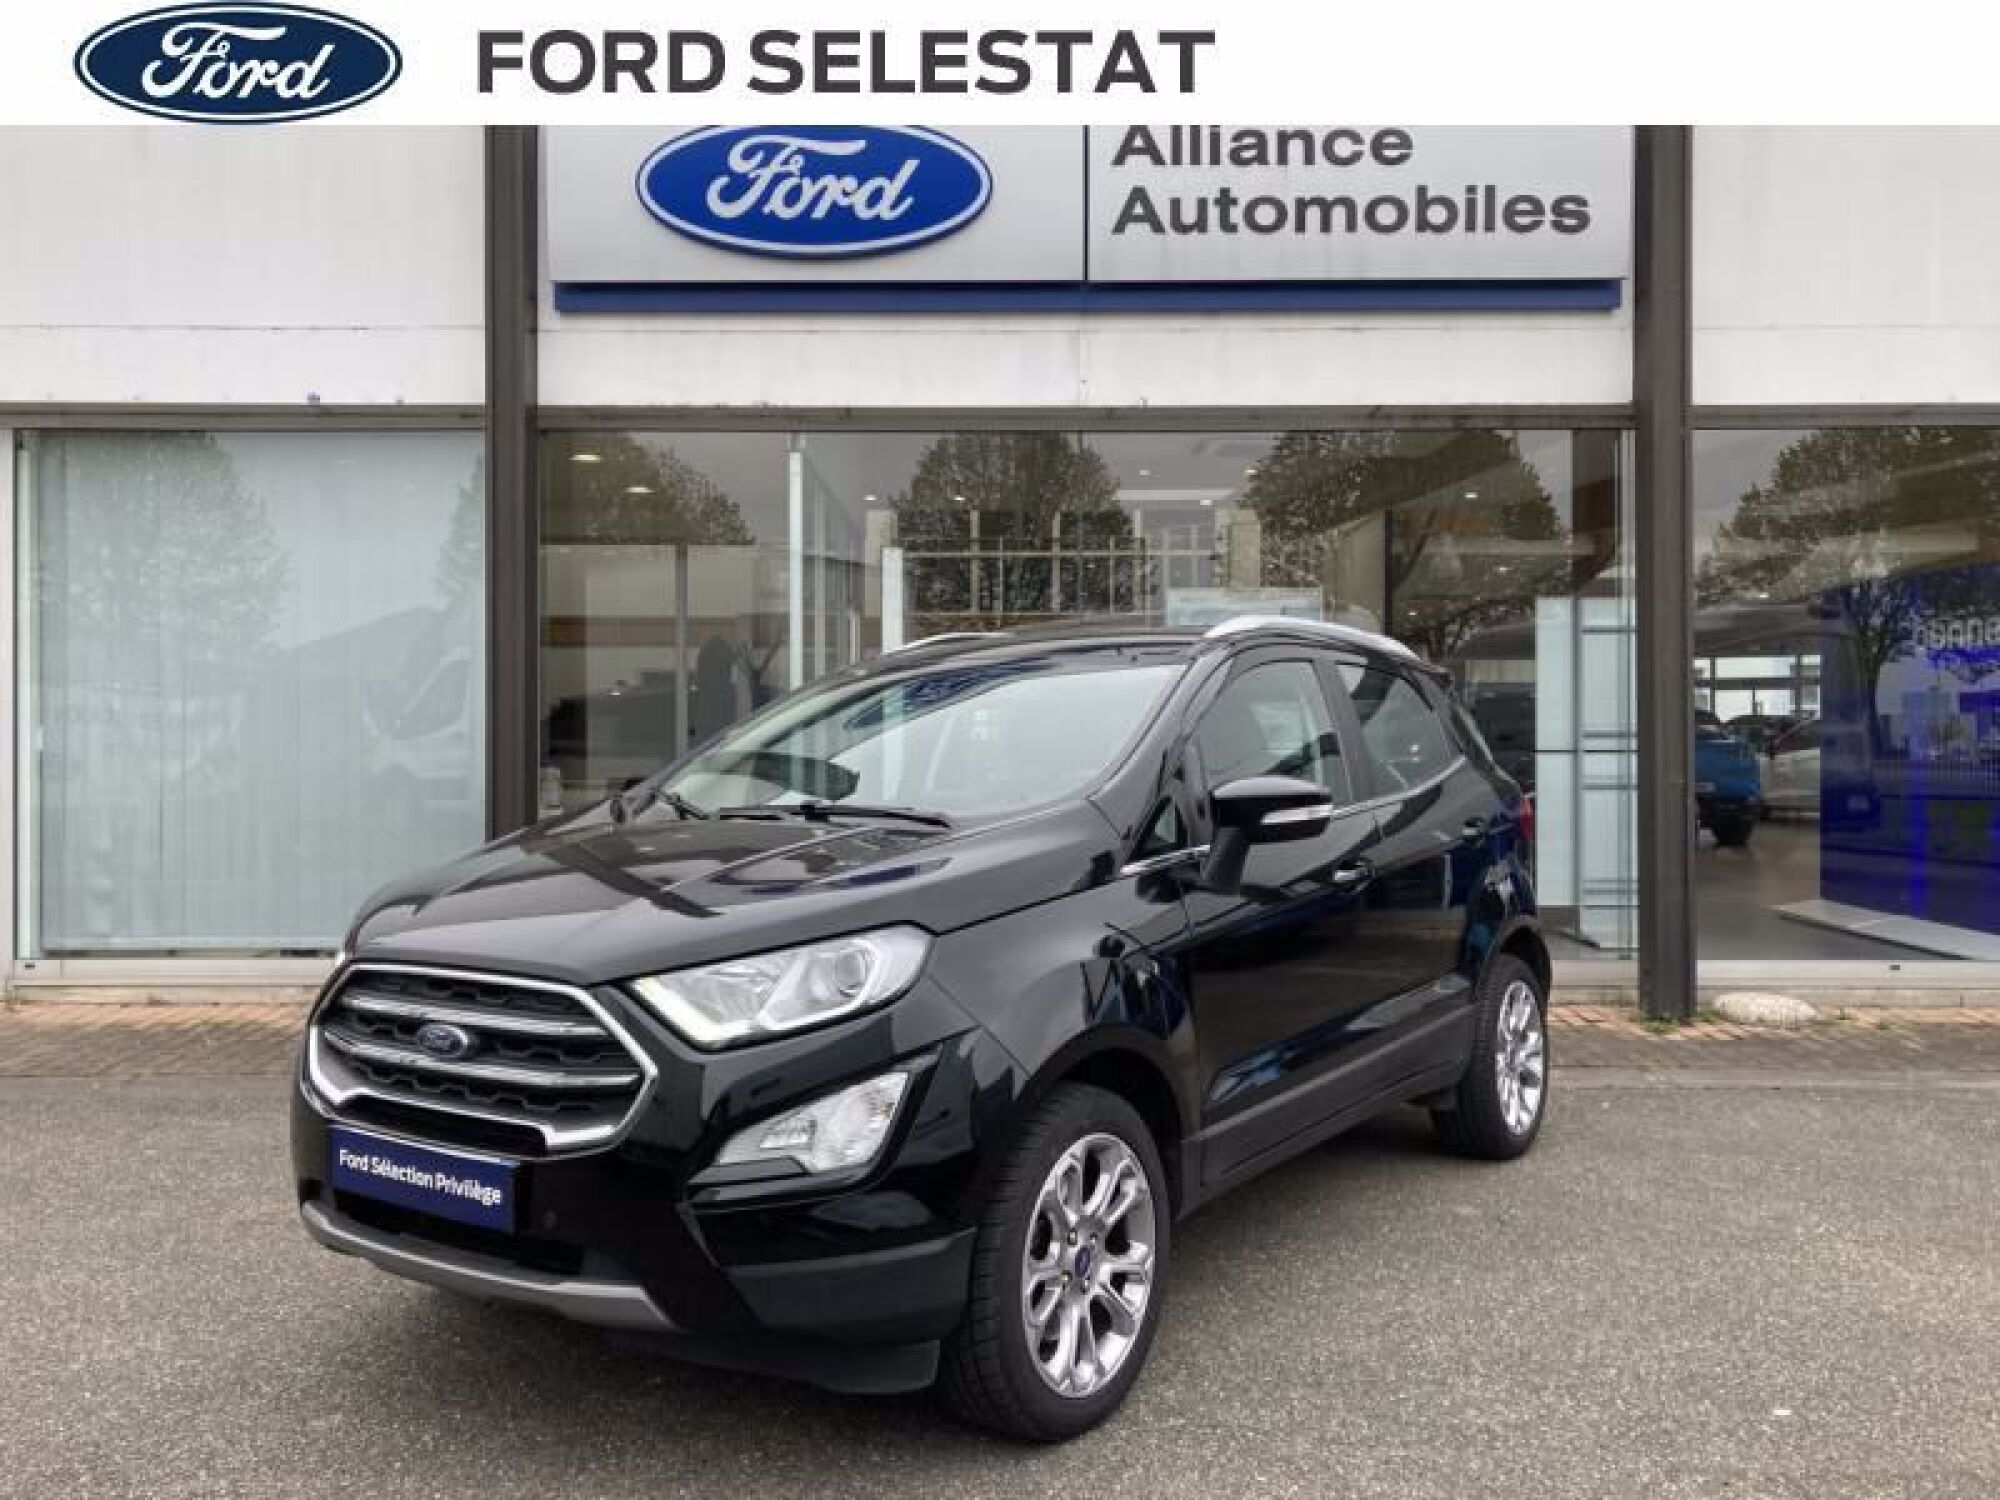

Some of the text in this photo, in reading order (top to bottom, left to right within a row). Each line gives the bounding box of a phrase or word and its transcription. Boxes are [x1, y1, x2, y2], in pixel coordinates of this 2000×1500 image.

[1111, 125, 1414, 166] Alliance
[706, 134, 920, 221] Ford
[1111, 184, 1592, 235] Automobiles
[339, 1148, 368, 1171] Ford
